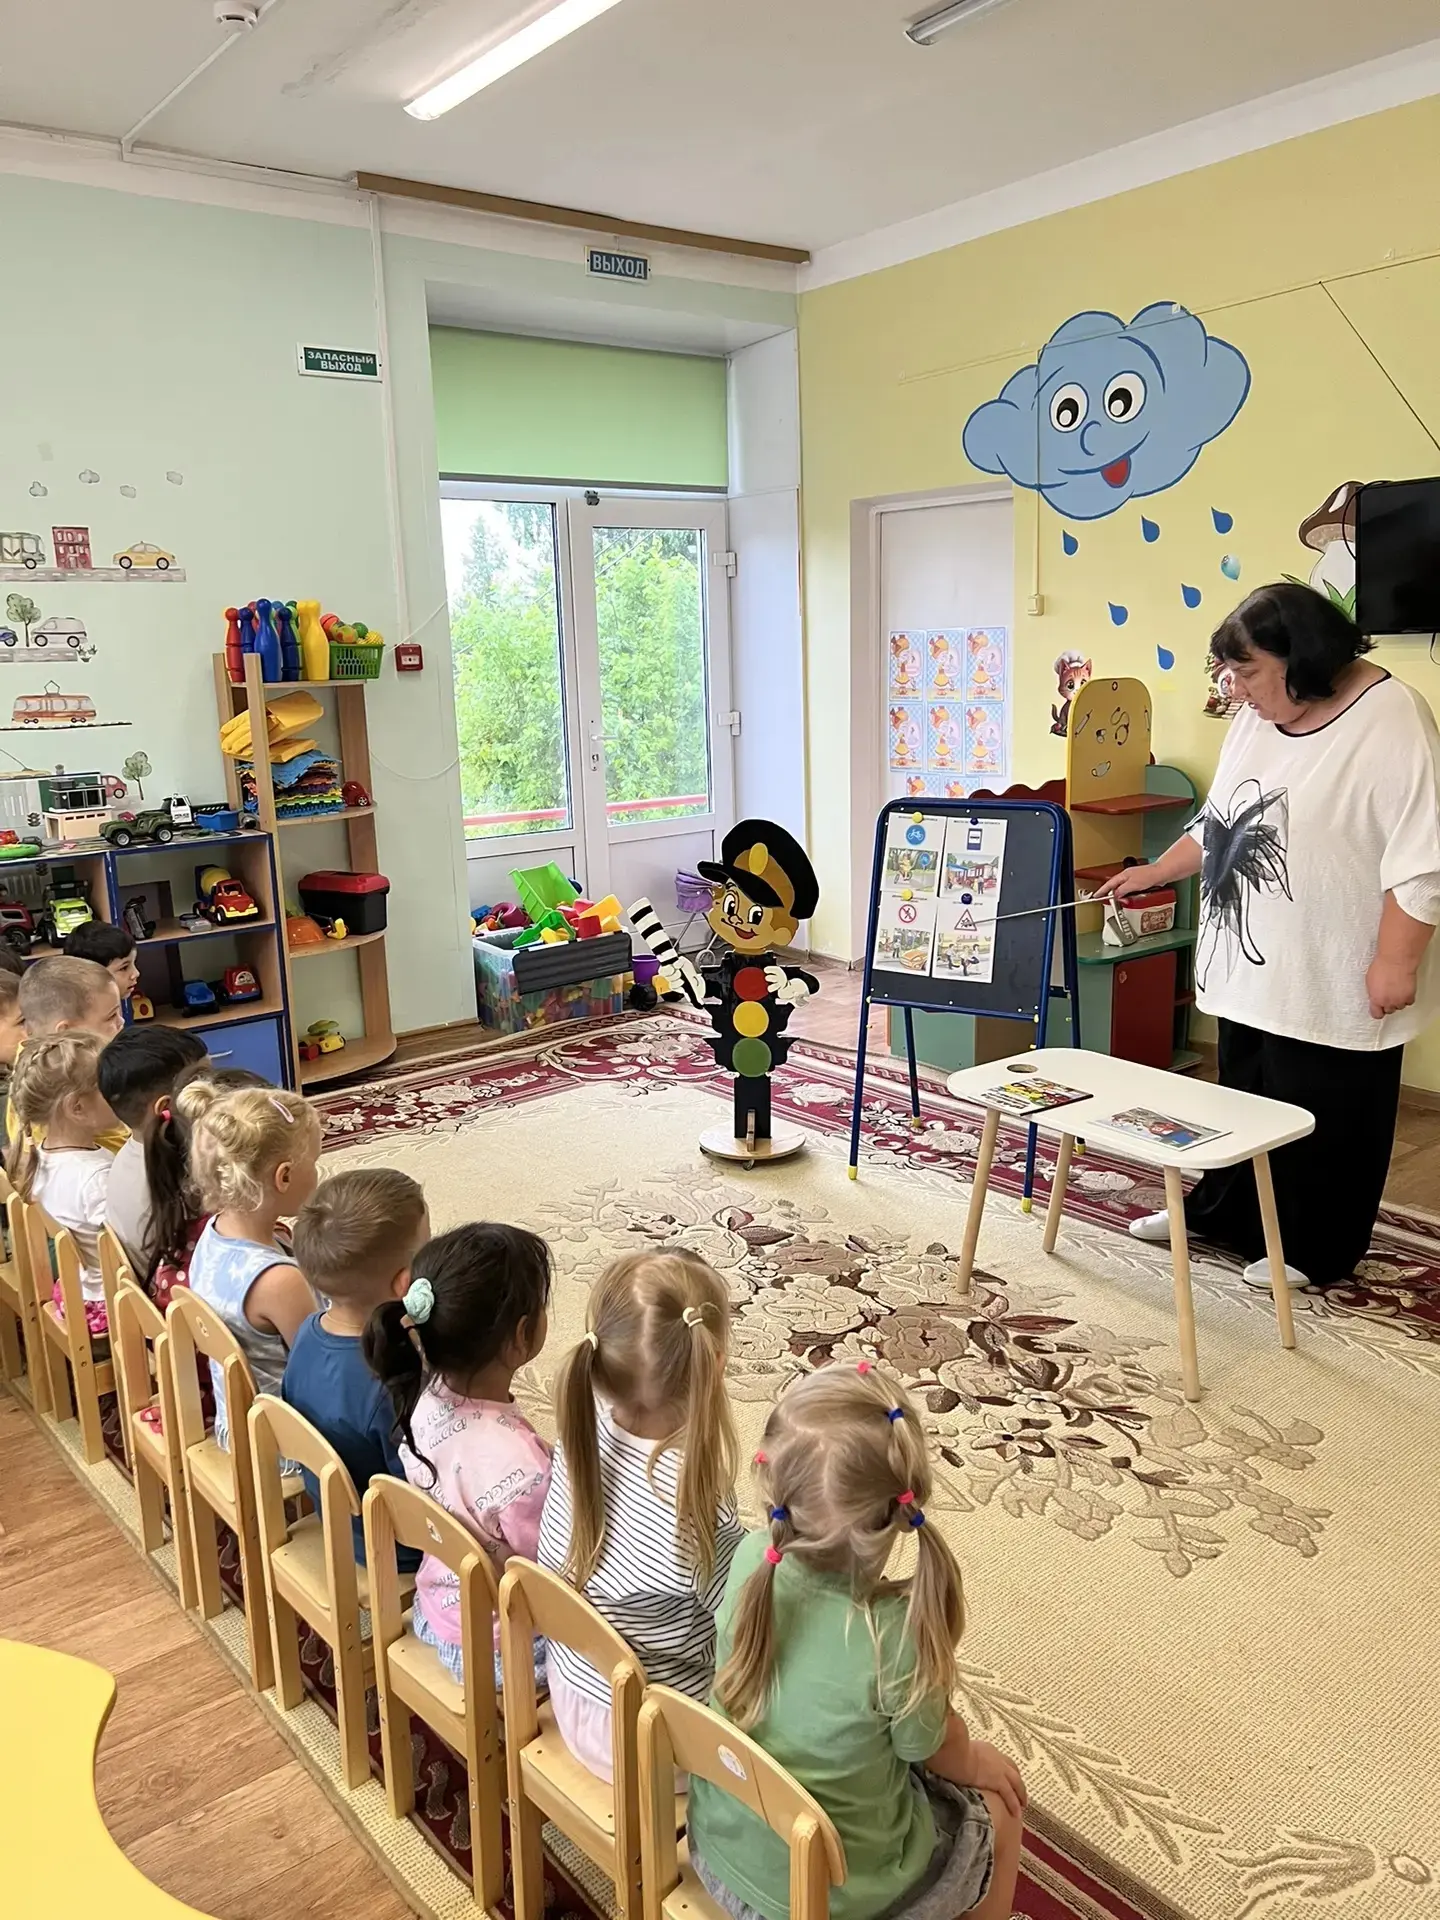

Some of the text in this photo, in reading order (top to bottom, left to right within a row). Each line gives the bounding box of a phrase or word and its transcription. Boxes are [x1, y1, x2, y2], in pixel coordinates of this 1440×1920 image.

[592, 253, 645, 278] ВЫХОД
[307, 351, 374, 364] ЗАПАСНЫЙ
[320, 360, 362, 372] ВЫХОД
